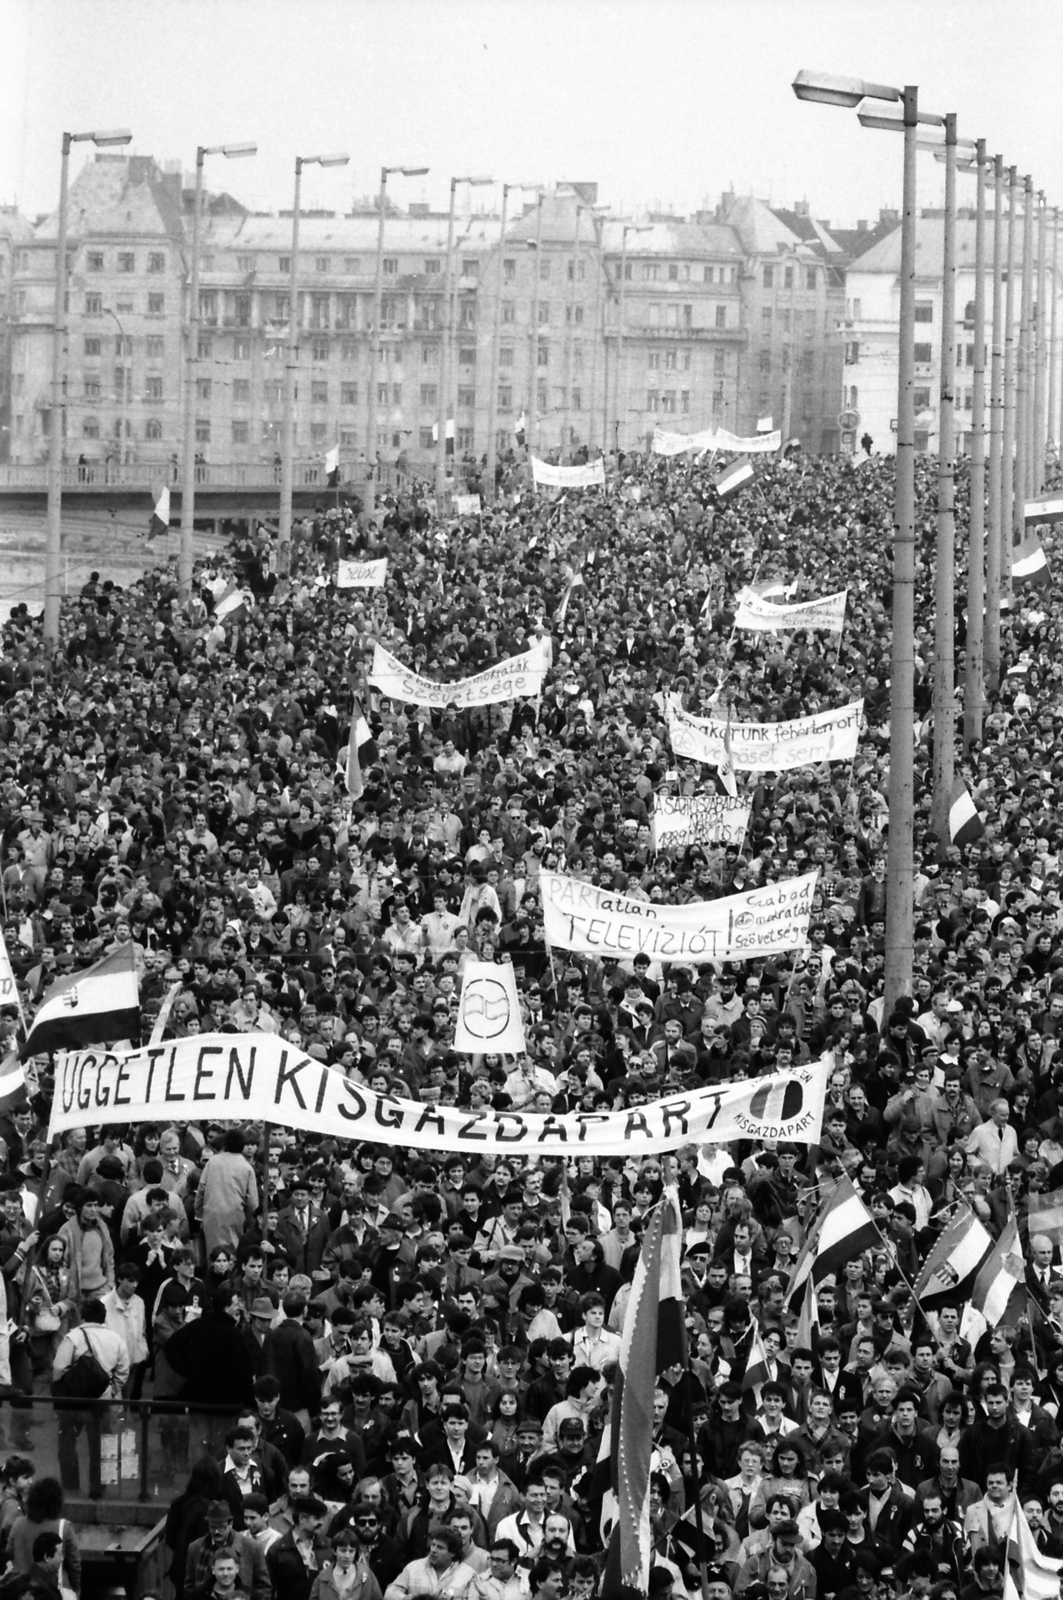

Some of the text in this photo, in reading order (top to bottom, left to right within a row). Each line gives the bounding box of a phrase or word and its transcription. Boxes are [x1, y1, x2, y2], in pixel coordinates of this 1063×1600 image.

[402, 677, 526, 703] Szövetsége
[786, 734, 835, 763] sem!
[745, 882, 811, 908] Szabad
[735, 922, 808, 949] Szövetsége
